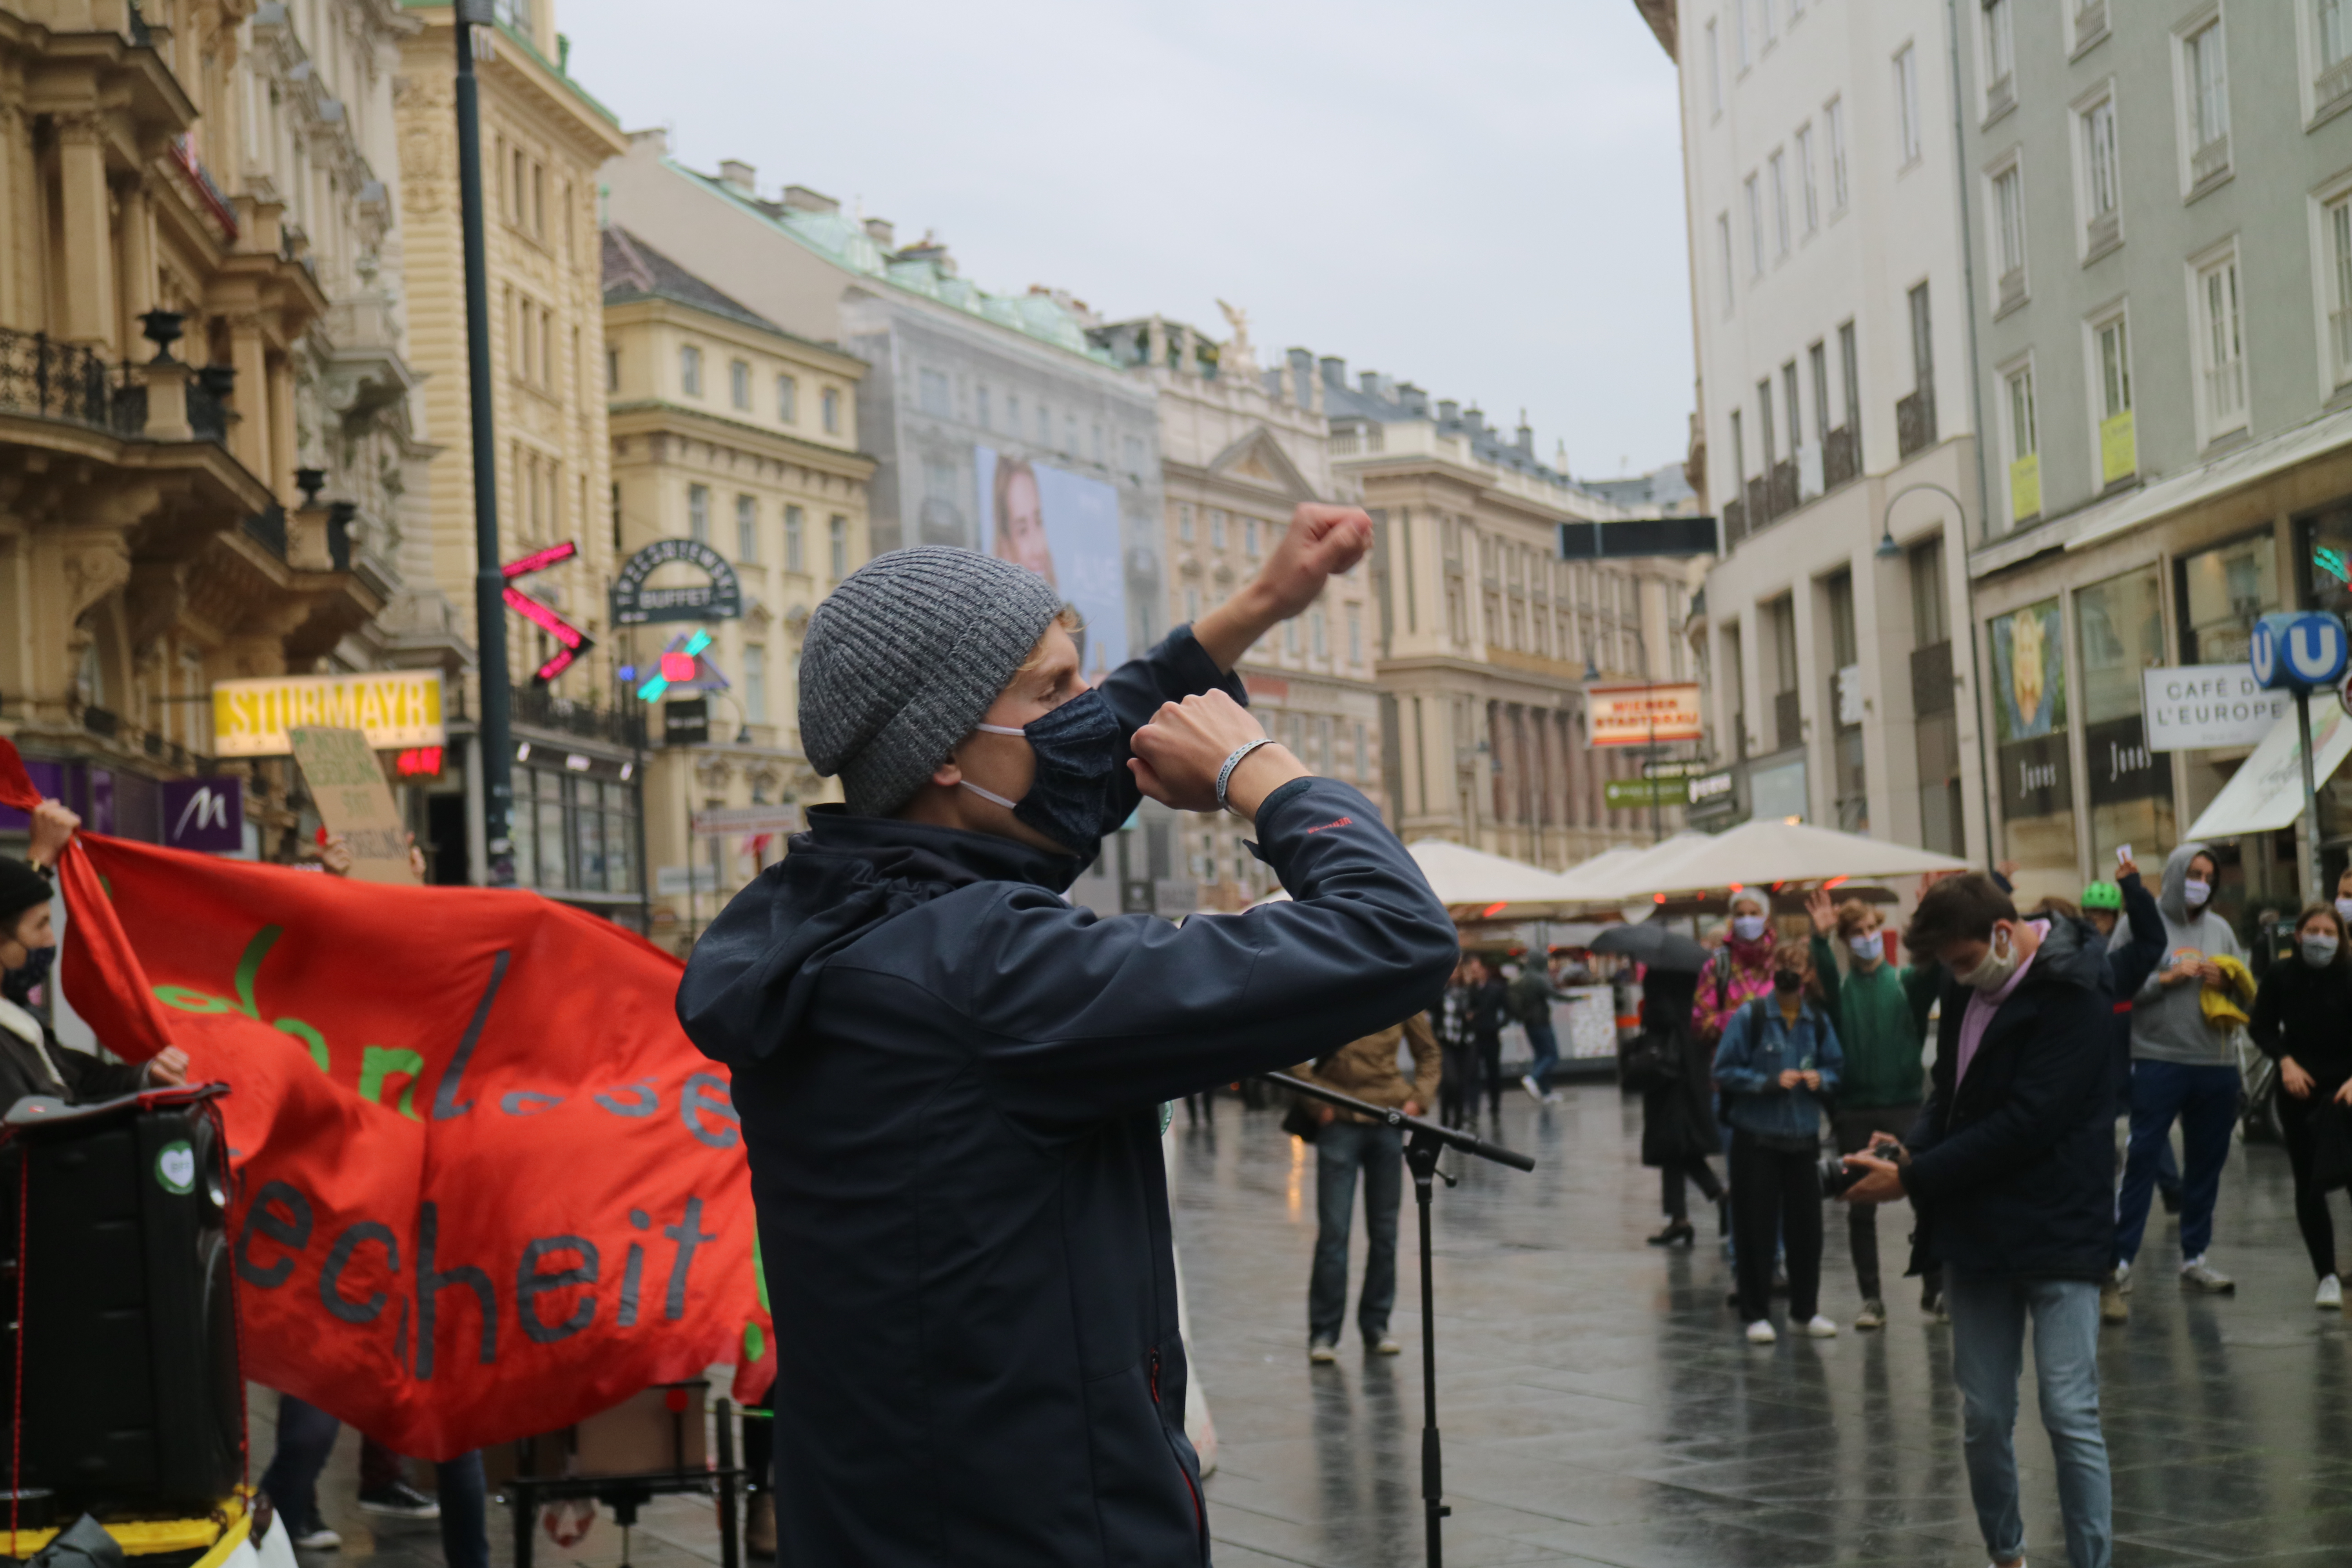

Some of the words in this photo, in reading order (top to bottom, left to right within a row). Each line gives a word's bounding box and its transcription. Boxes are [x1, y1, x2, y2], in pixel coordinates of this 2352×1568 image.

[640, 588, 710, 609] BUFFET
[2252, 630, 2272, 682] U
[2289, 625, 2337, 678] U
[2166, 677, 2228, 701] CAFÉ
